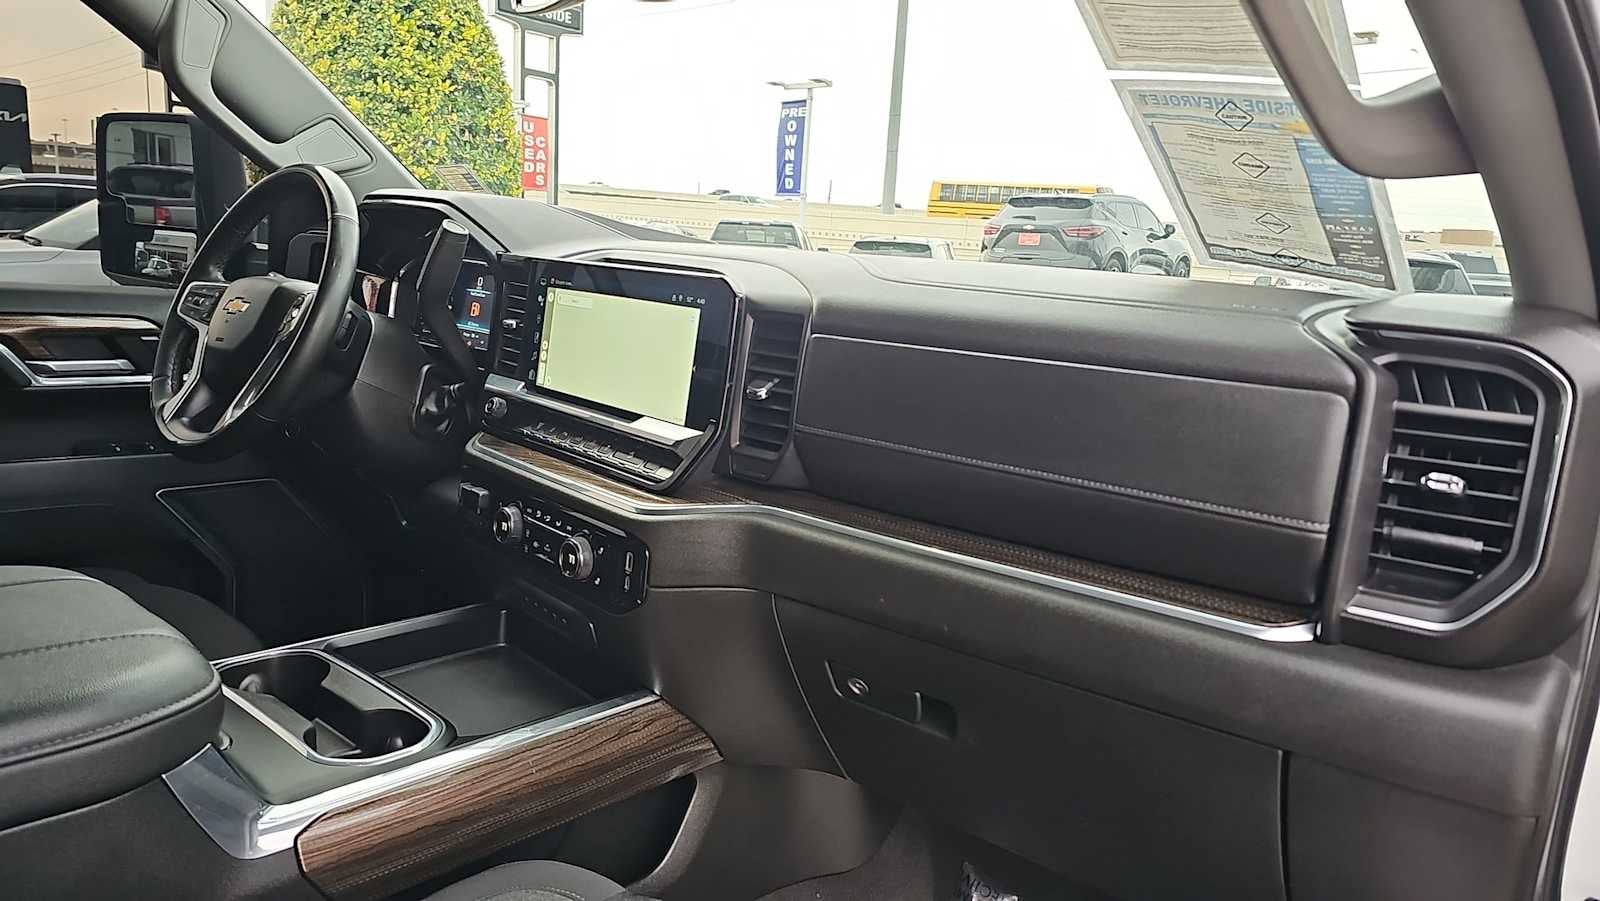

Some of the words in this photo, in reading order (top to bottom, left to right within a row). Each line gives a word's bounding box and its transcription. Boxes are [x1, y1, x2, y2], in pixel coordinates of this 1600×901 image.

[540, 10, 572, 24] SIDE
[782, 107, 807, 117] PRE
[523, 121, 534, 173] USED
[535, 136, 546, 186] CARS
[784, 120, 798, 190] OWNED
